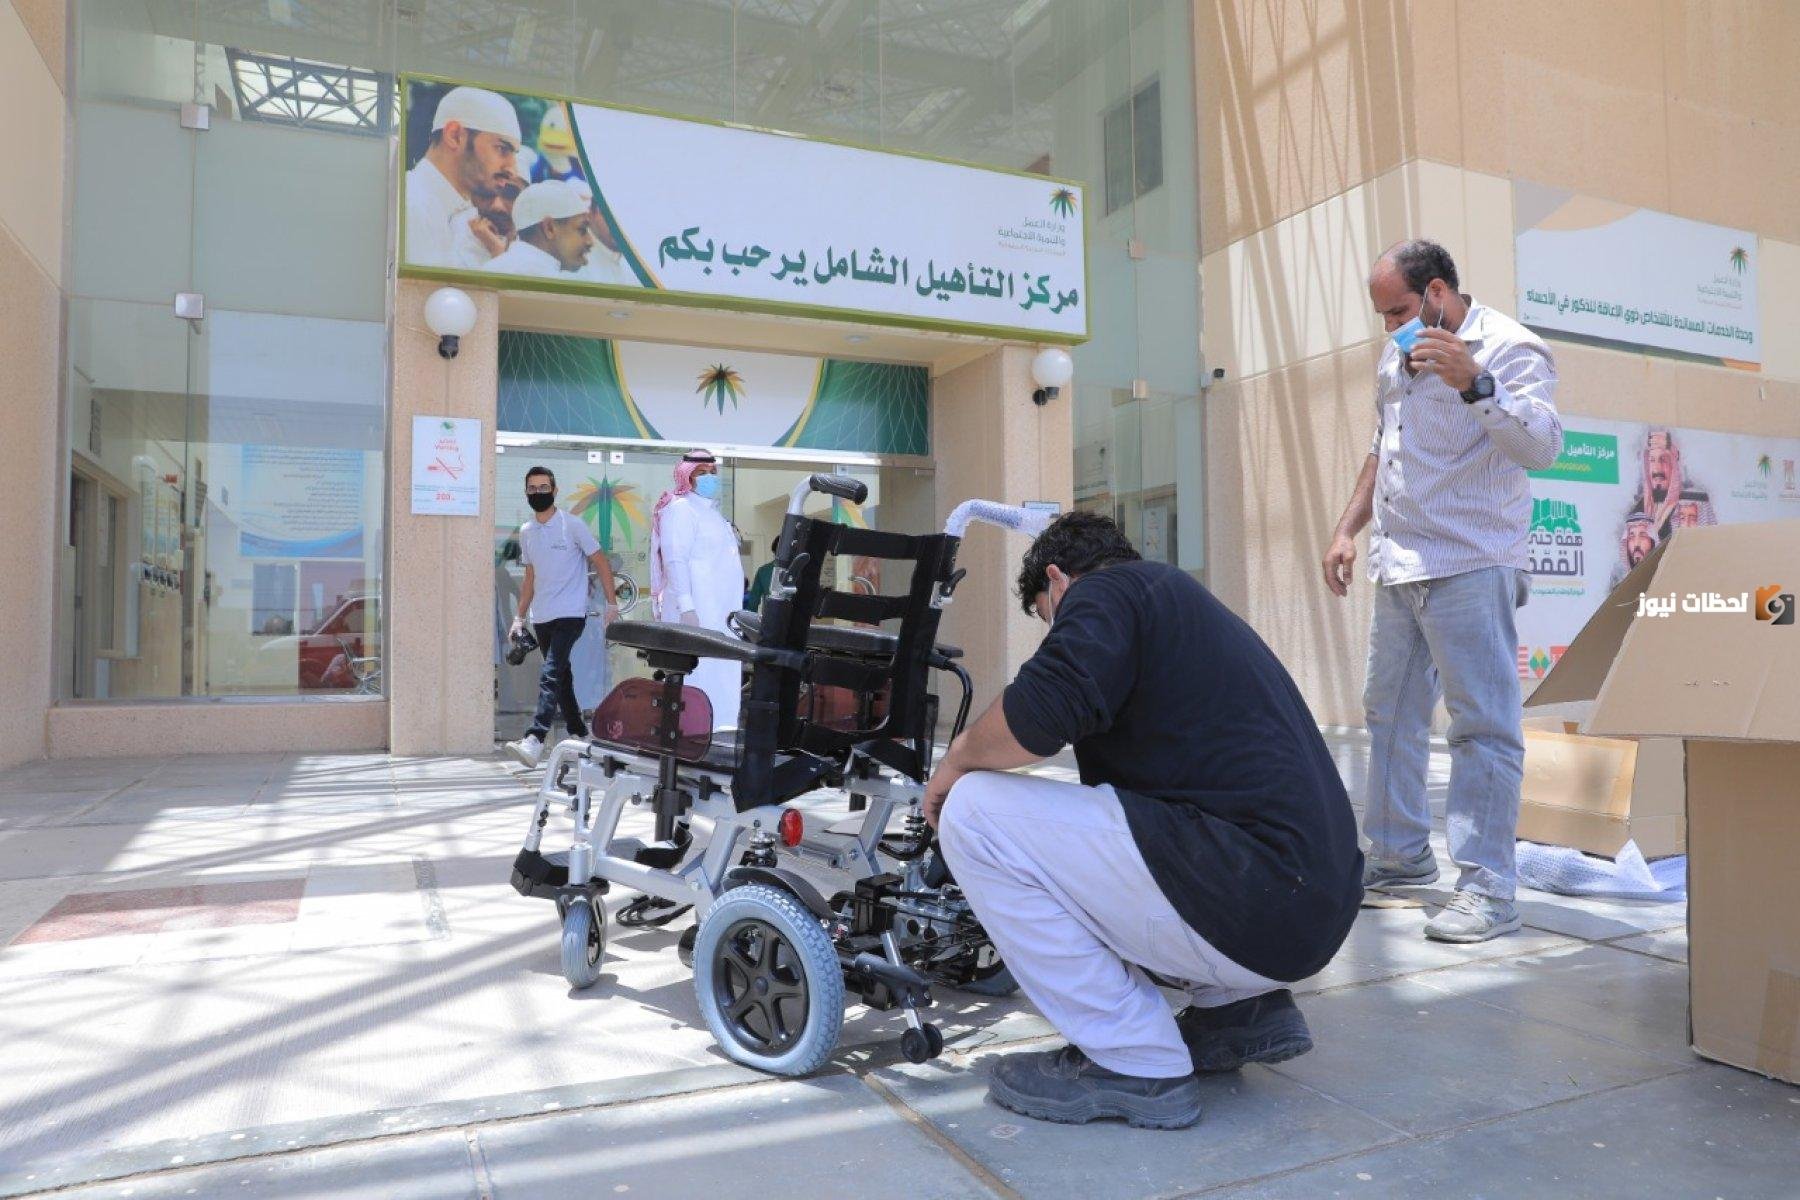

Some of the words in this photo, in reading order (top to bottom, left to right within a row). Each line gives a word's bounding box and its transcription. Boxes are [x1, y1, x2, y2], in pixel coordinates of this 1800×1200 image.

[658, 226, 714, 276] بكم
[722, 242, 809, 286] يرحب
[813, 246, 908, 285] الشامل
[916, 258, 1014, 302] التأهيل
[1019, 272, 1079, 314] مركز
[1567, 443, 1596, 458] التأهيل
[1597, 445, 1615, 461] مركز
[1555, 528, 1583, 547] همة
